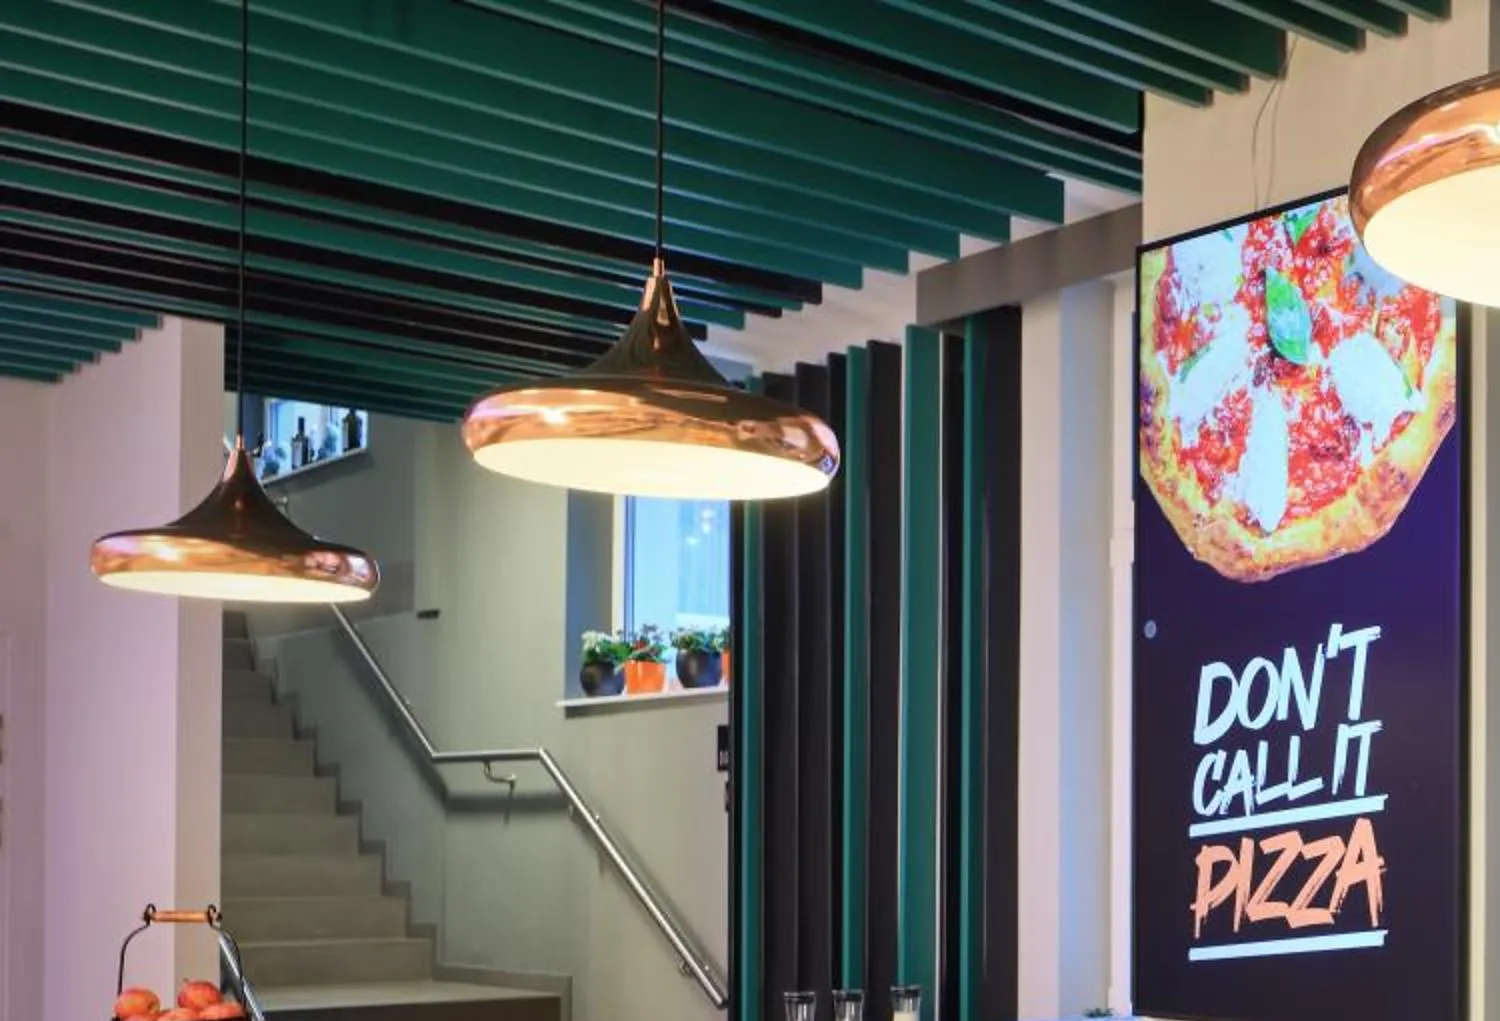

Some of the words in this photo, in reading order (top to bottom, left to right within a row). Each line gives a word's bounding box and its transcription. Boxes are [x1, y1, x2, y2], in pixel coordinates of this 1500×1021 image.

[1193, 623, 1382, 745] DON'T
[1192, 735, 1324, 816] CALL
[1332, 720, 1382, 796] IT
[1190, 817, 1388, 939] PIZZA
